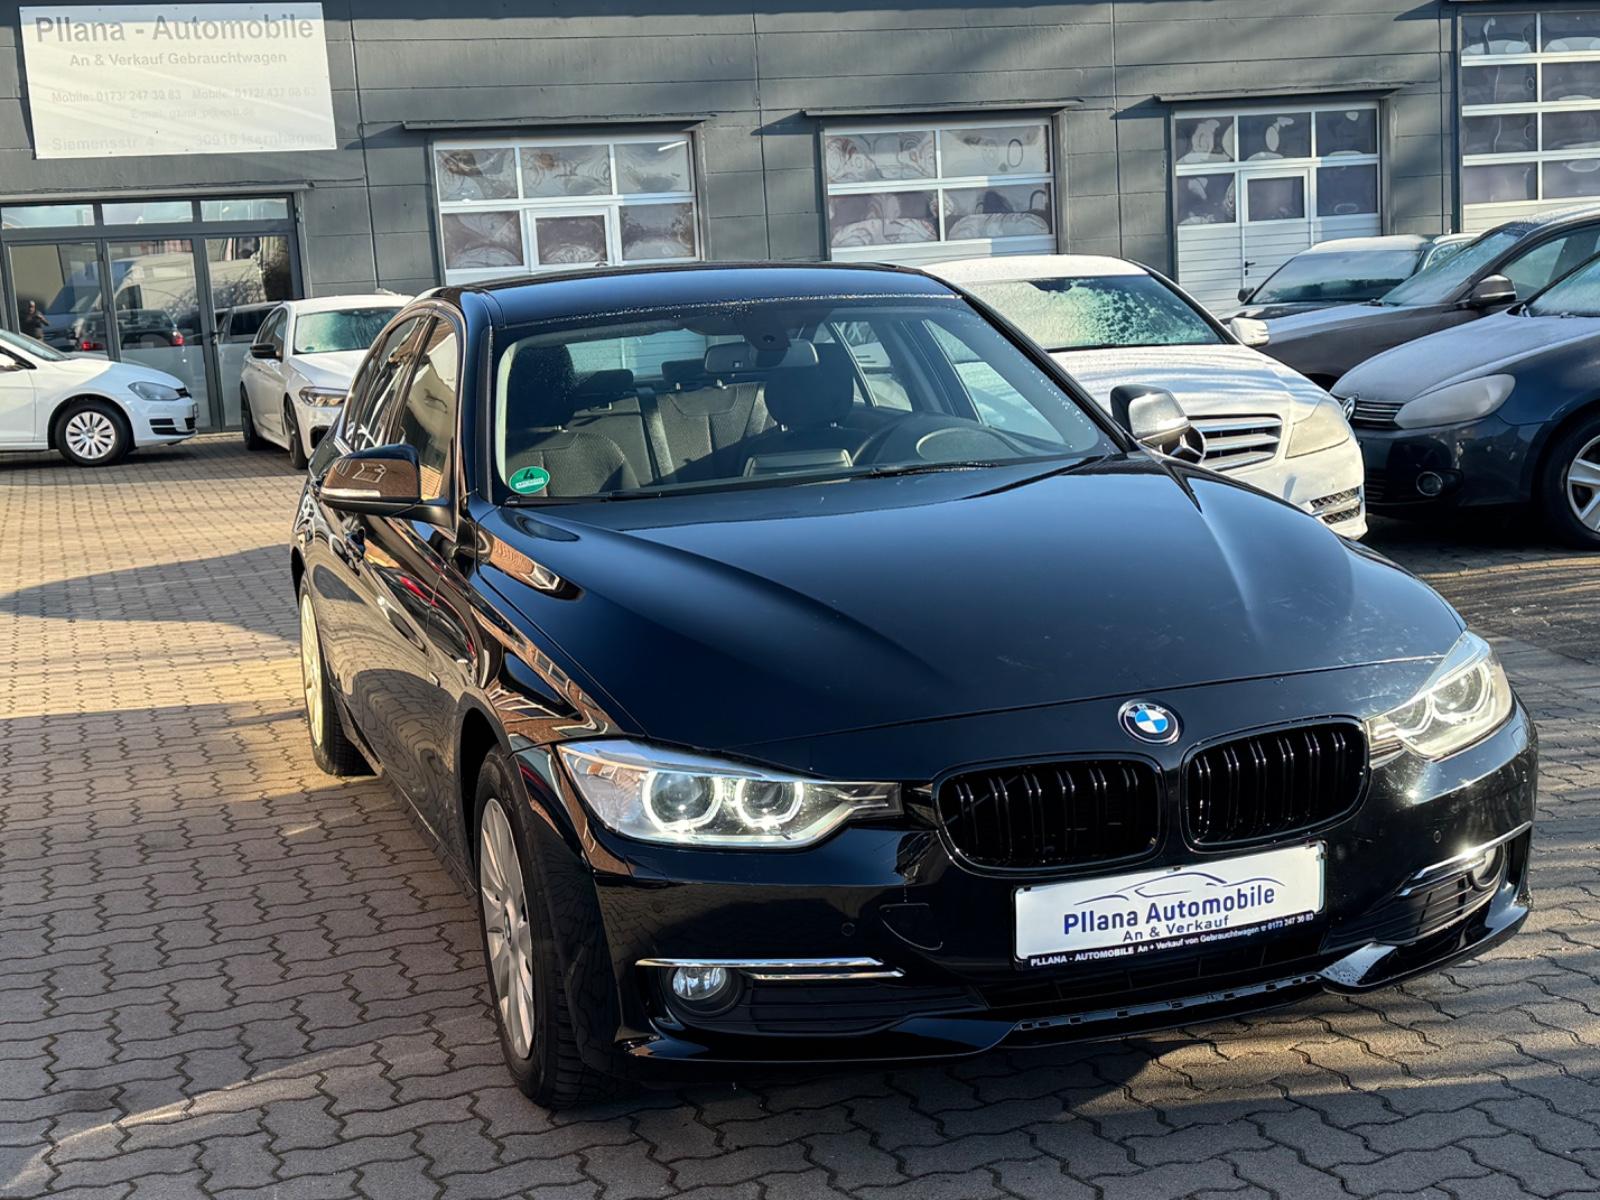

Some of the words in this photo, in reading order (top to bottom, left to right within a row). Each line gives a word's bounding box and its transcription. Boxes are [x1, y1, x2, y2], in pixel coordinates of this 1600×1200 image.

[35, 16, 125, 42] Pllana
[152, 14, 313, 41] Automobile
[69, 54, 90, 67] An
[94, 54, 105, 66] &
[109, 52, 164, 66] Verkauf
[167, 52, 287, 67] Gebrauchtwagen
[523, 469, 535, 479] 4
[1063, 910, 1138, 935] Pllana
[1145, 884, 1275, 924] Automobile
[1122, 930, 1143, 942] An
[1149, 926, 1160, 938] &
[1166, 915, 1229, 935] Verkauf
[1030, 953, 1068, 967] PLLANA
[1074, 946, 1134, 962] AUTOMOBILE
[1137, 945, 1148, 954] An
[1155, 938, 1184, 950] Verkauf
[1185, 936, 1199, 946] von
[1200, 925, 1261, 943] Gebrauchtwagen
